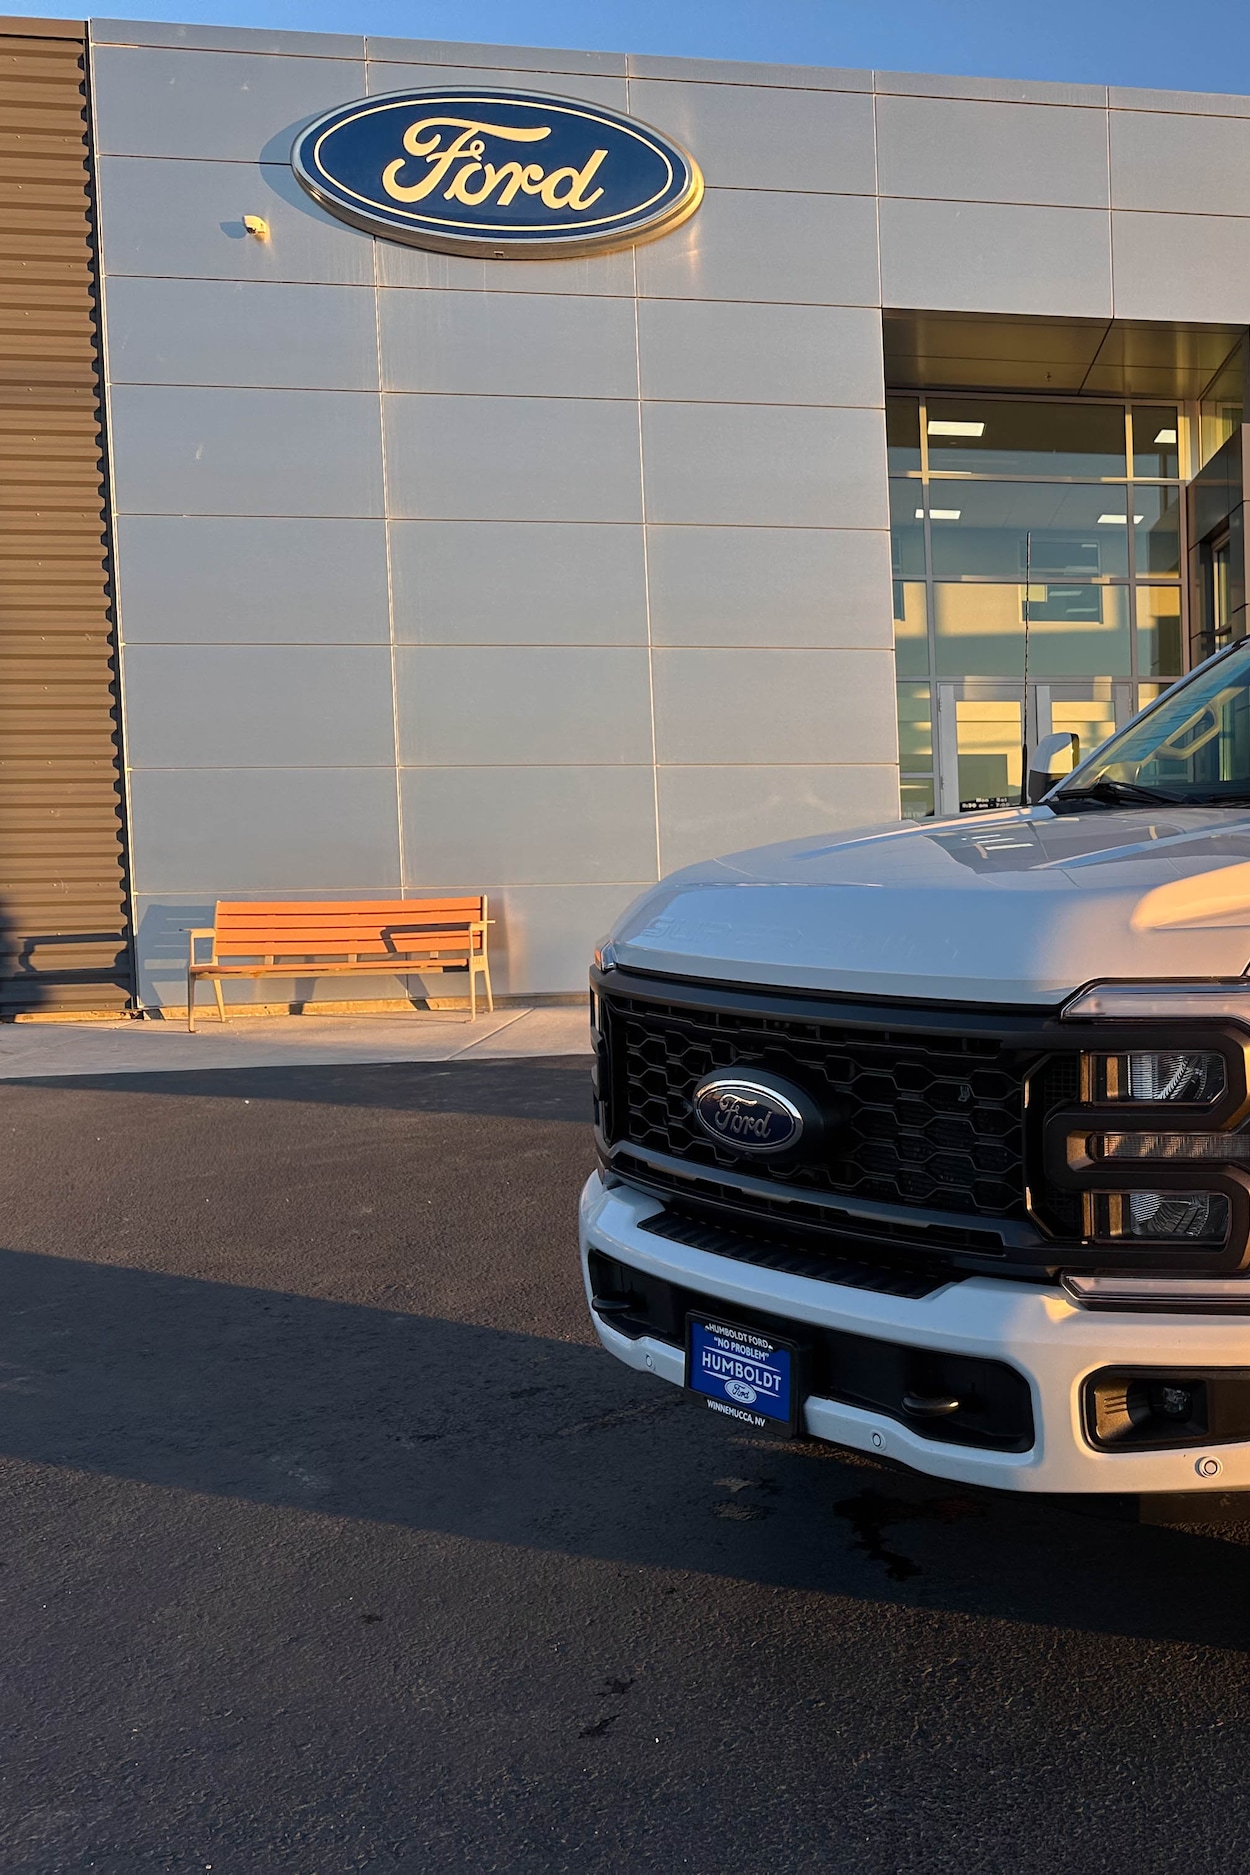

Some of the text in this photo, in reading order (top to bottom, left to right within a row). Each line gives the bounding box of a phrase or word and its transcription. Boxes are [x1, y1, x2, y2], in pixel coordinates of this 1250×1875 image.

[382, 116, 608, 212] Ford
[716, 1093, 772, 1139] Ford
[708, 1322, 769, 1349] HUMBOLDT FORD
[701, 1350, 782, 1392] HUMBOLDT
[731, 1384, 750, 1400] Ford
[754, 1415, 766, 1428] NV
